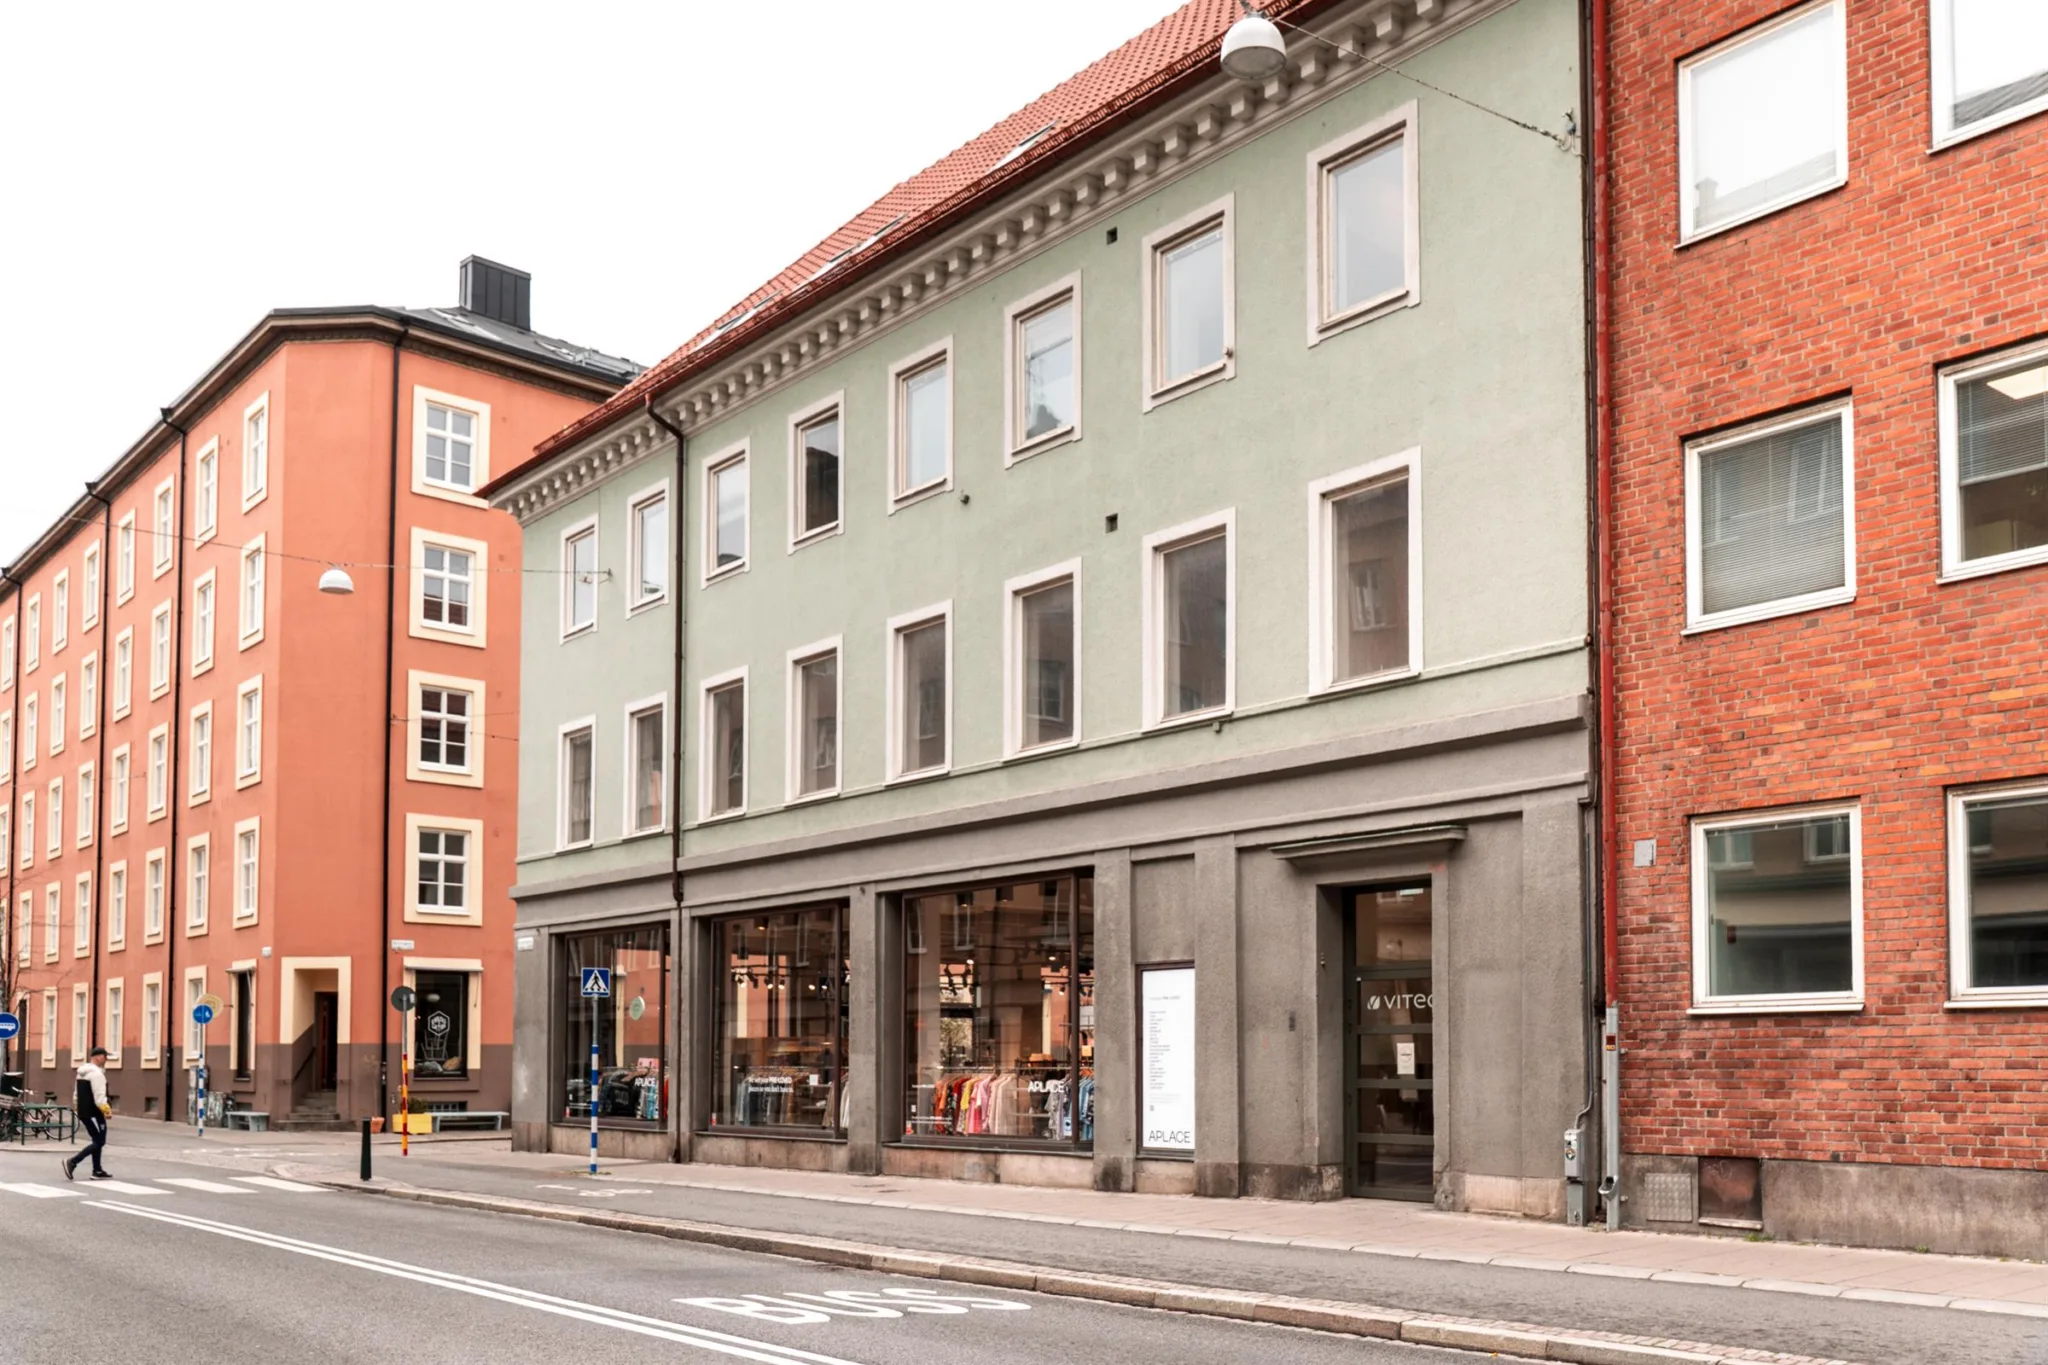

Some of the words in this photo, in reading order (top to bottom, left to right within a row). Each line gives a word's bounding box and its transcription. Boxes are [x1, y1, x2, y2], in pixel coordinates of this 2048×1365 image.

[1027, 1080, 1065, 1093] APLACE
[1148, 1130, 1191, 1144] APLACE
[672, 1288, 1032, 1325] BUSS
